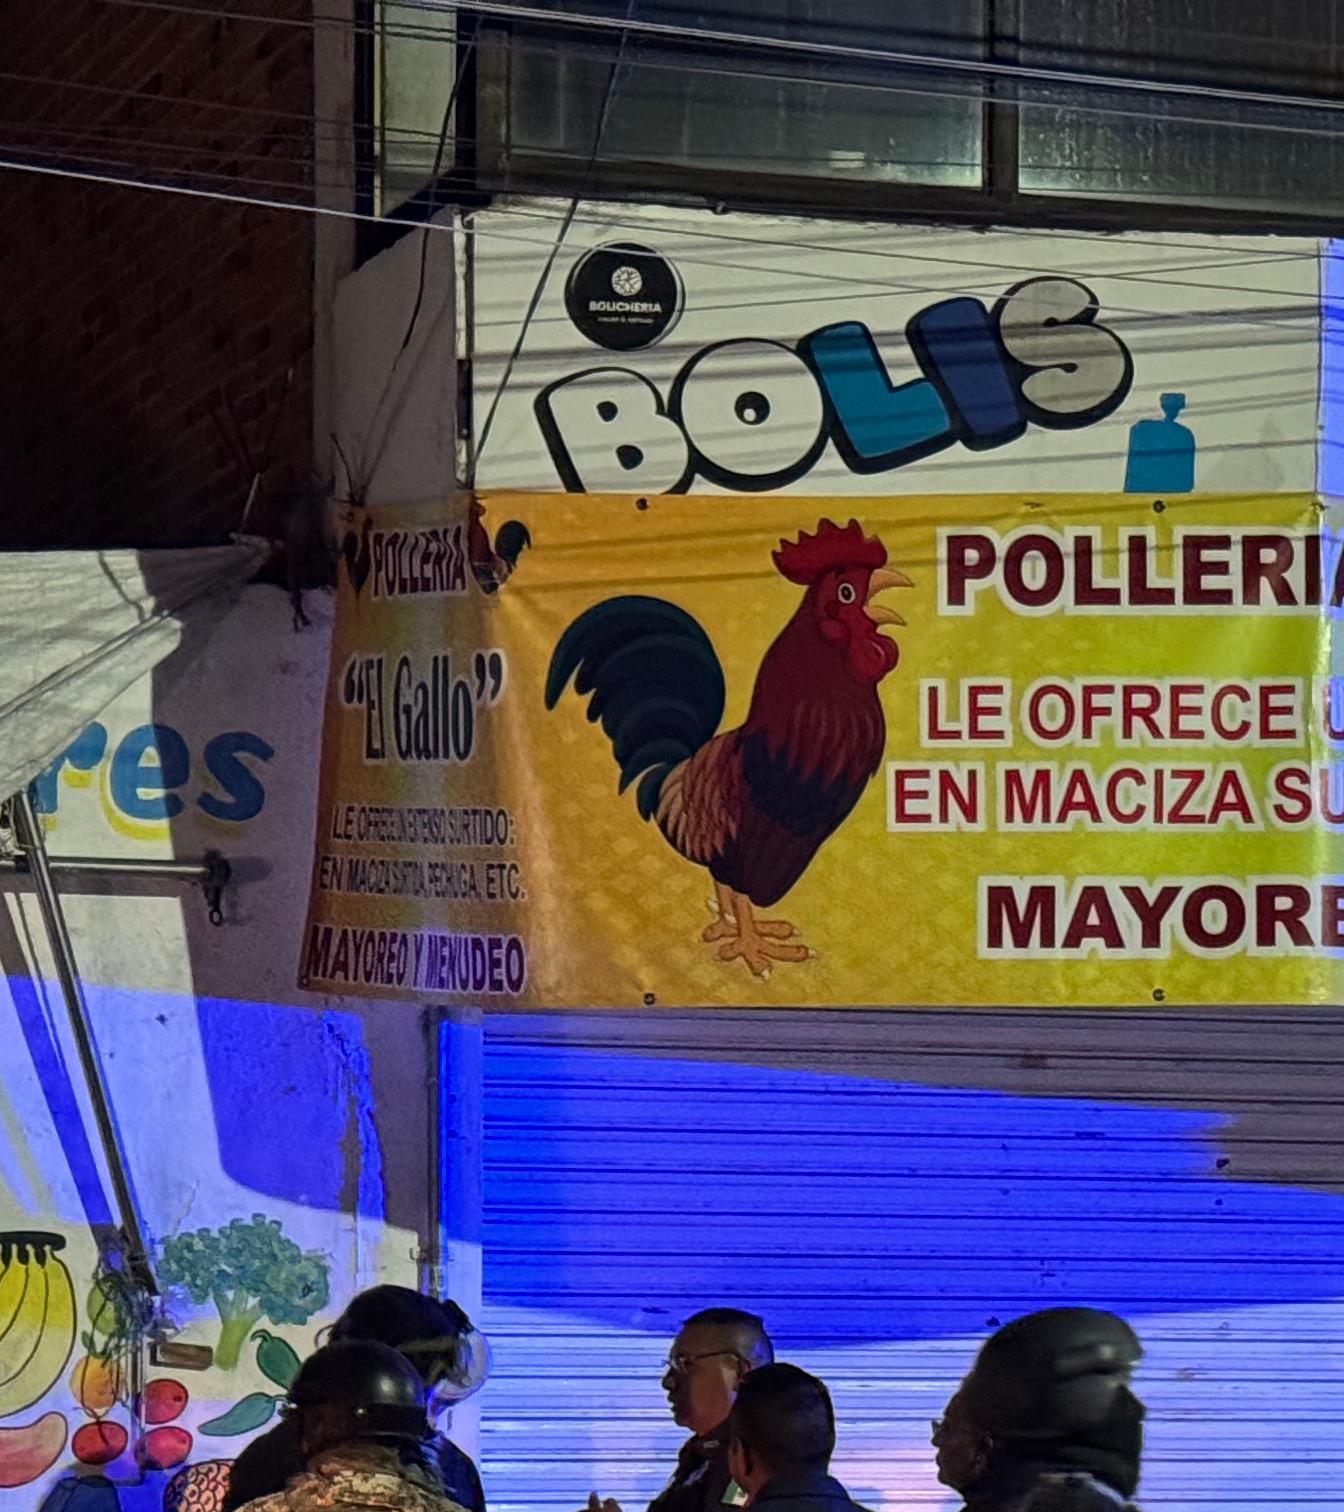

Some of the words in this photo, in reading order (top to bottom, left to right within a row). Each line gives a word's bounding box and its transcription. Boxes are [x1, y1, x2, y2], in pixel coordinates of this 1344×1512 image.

[534, 275, 1135, 494] BOLIS
[373, 525, 466, 597] POLLERIA
[927, 685, 1005, 740] LE
[1028, 684, 1297, 741] OFRECE
[894, 769, 977, 824] EN
[1004, 768, 1255, 825] MACIZA
[308, 925, 408, 987] MAYOREO
